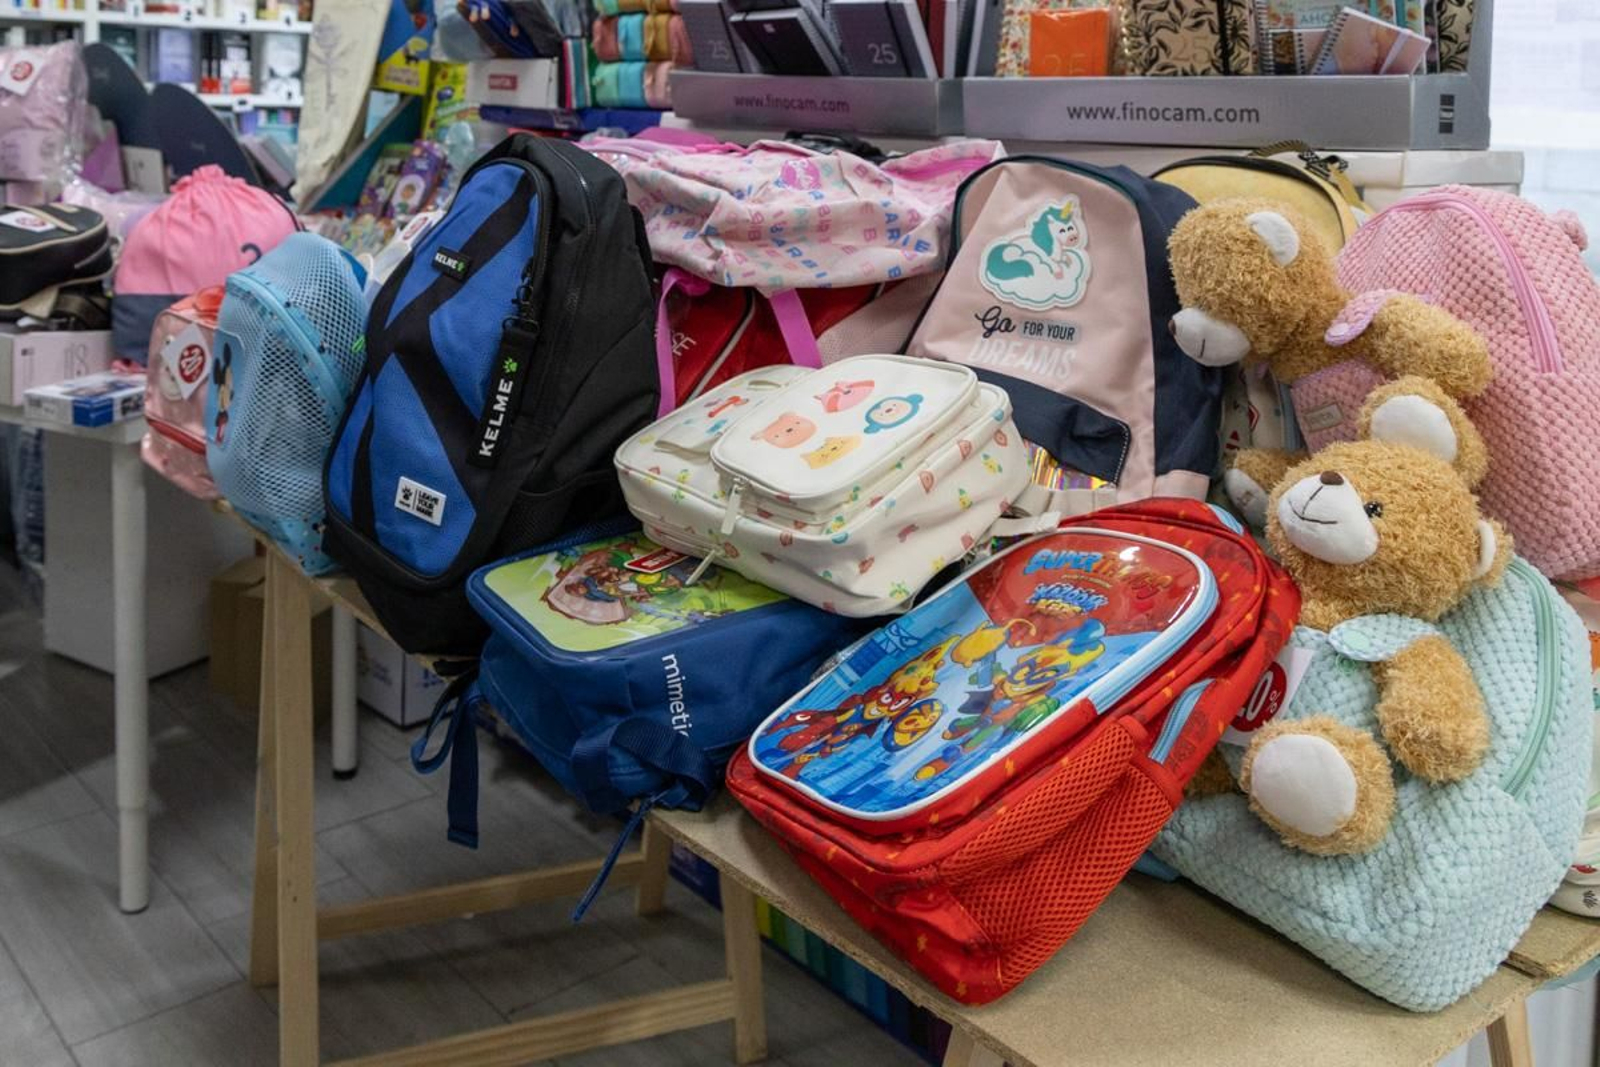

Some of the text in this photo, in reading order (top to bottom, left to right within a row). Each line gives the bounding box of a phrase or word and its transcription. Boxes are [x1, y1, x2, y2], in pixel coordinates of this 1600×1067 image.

[868, 43, 898, 65] 25
[732, 91, 850, 114] www.finocam.com
[1066, 101, 1261, 125] www.finocam.com
[974, 305, 1076, 342] Go FOR YOUR
[968, 336, 1078, 381] DREAMS
[479, 378, 513, 457] KELME
[1023, 548, 1102, 576] SUPER
